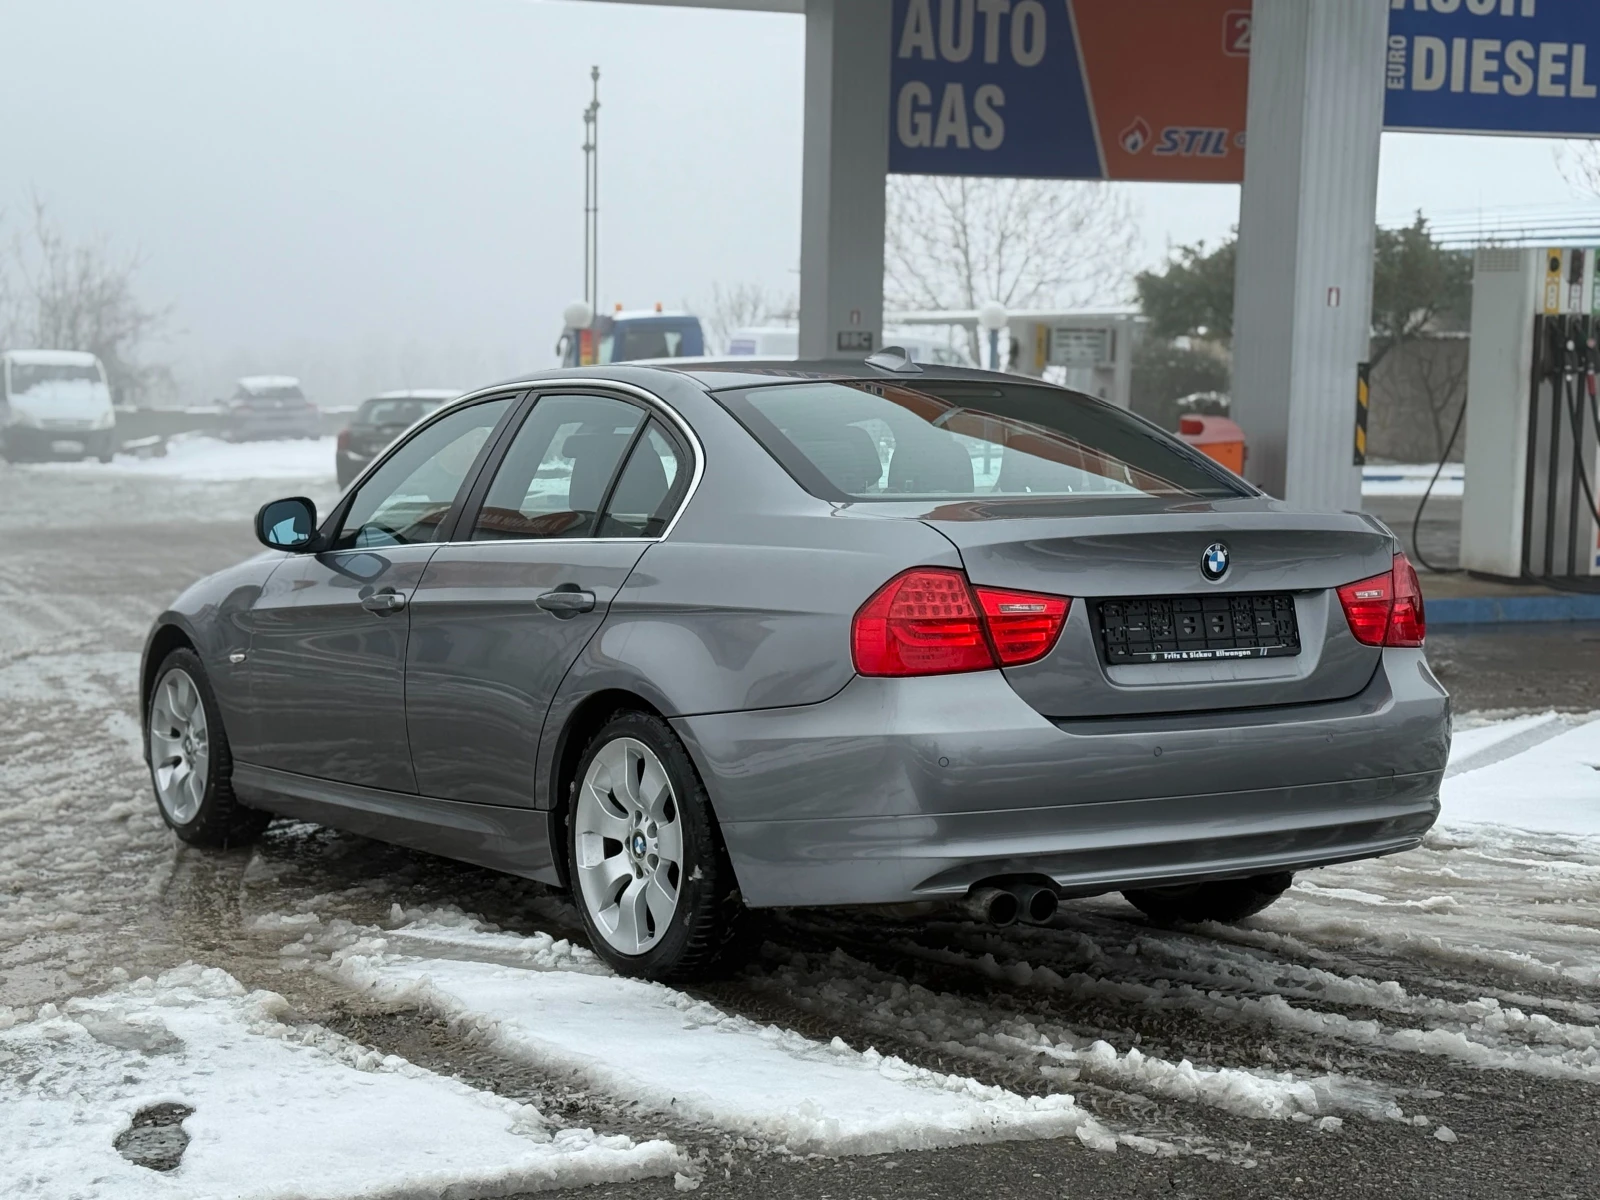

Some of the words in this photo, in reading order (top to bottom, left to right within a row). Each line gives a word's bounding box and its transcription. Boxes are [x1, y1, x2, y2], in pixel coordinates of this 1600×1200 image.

[899, 0, 1046, 67] AUTO
[1387, 35, 1407, 90] EURO
[1411, 36, 1597, 98] DIESEL
[897, 80, 1006, 151] GAS
[1153, 125, 1229, 157] STIL
